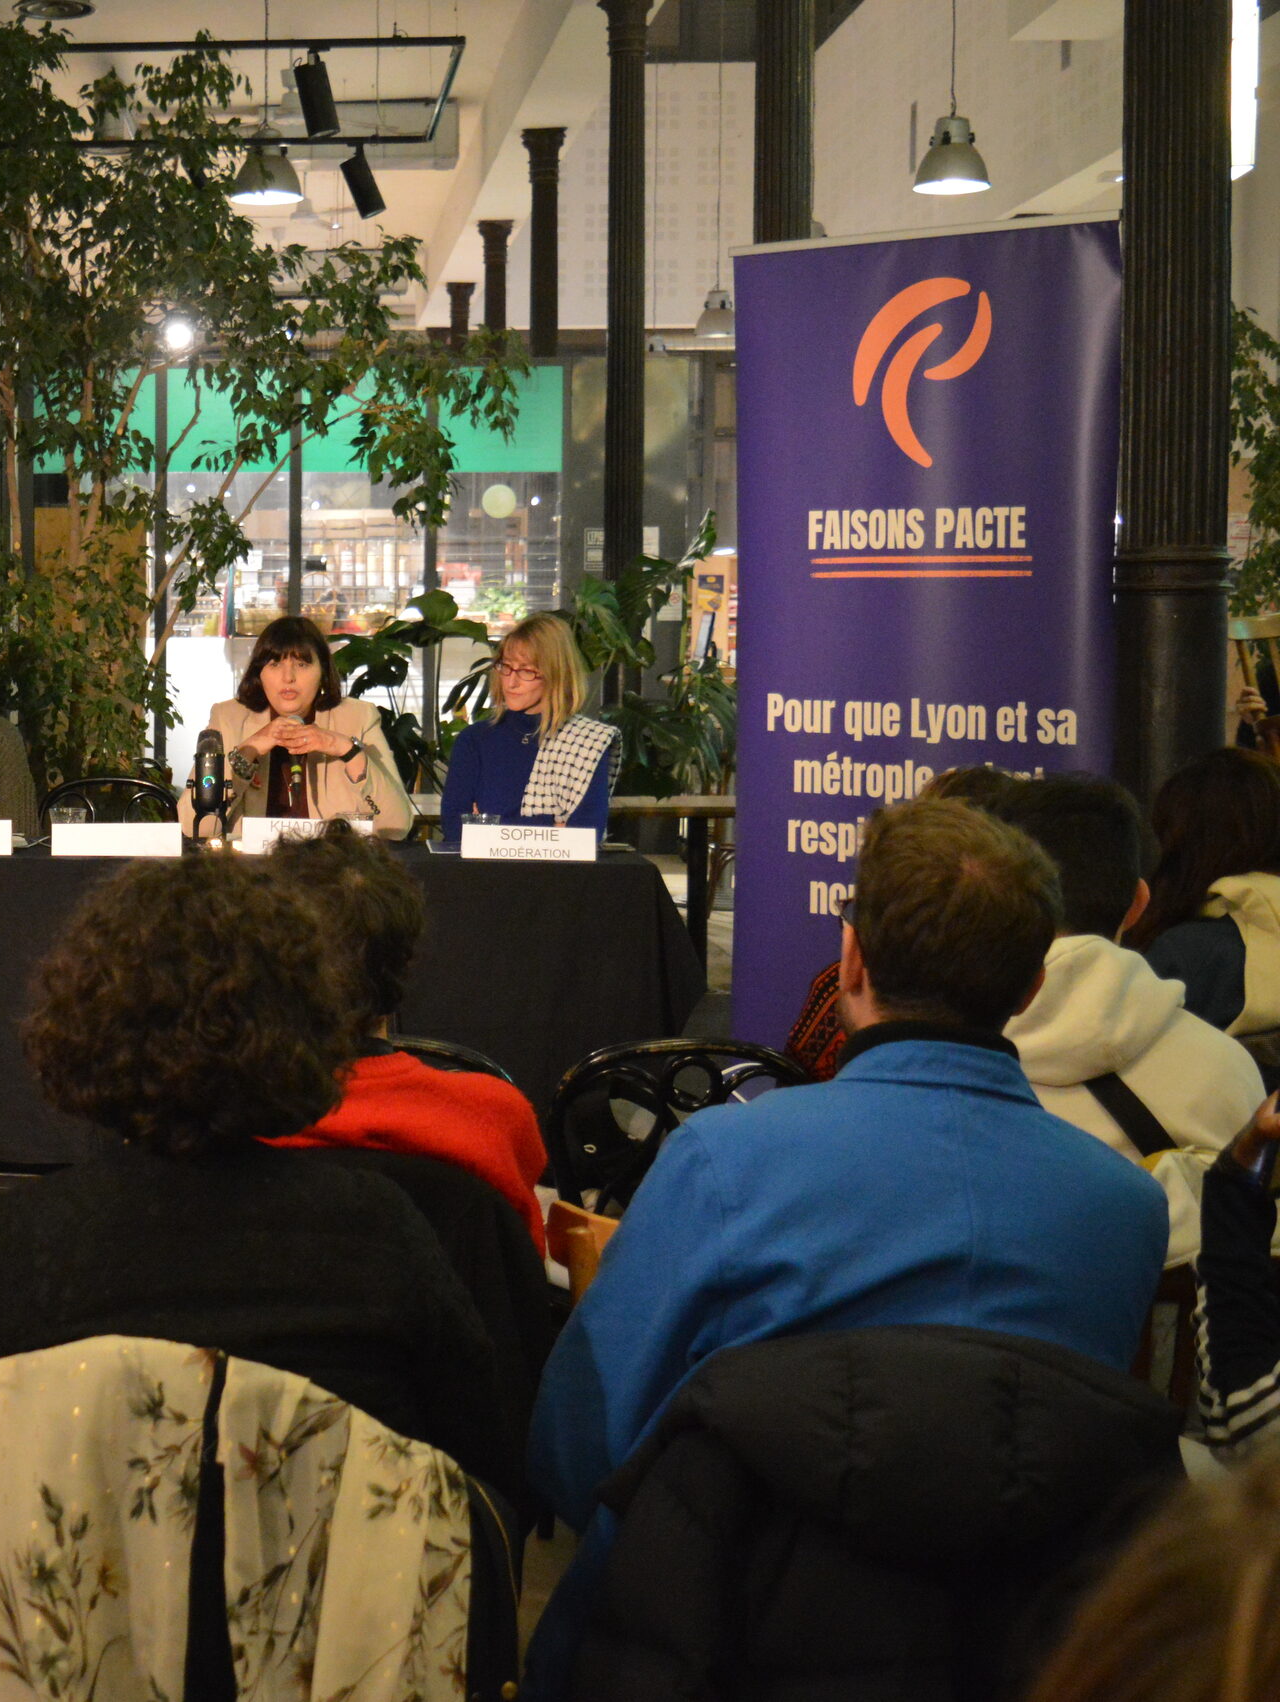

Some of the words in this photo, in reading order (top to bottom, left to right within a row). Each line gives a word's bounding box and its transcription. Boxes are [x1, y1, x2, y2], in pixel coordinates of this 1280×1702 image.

[807, 508, 925, 550] FAISONS
[935, 506, 1026, 549] PACTE
[766, 692, 835, 734] Pour
[844, 700, 901, 742] que
[910, 697, 986, 744] Lyon
[996, 701, 1028, 743] et
[1036, 708, 1077, 745] sa
[793, 751, 934, 804] métrople
[270, 820, 320, 835] KHADI
[500, 828, 559, 842] SOPHIE
[787, 816, 865, 862] respi
